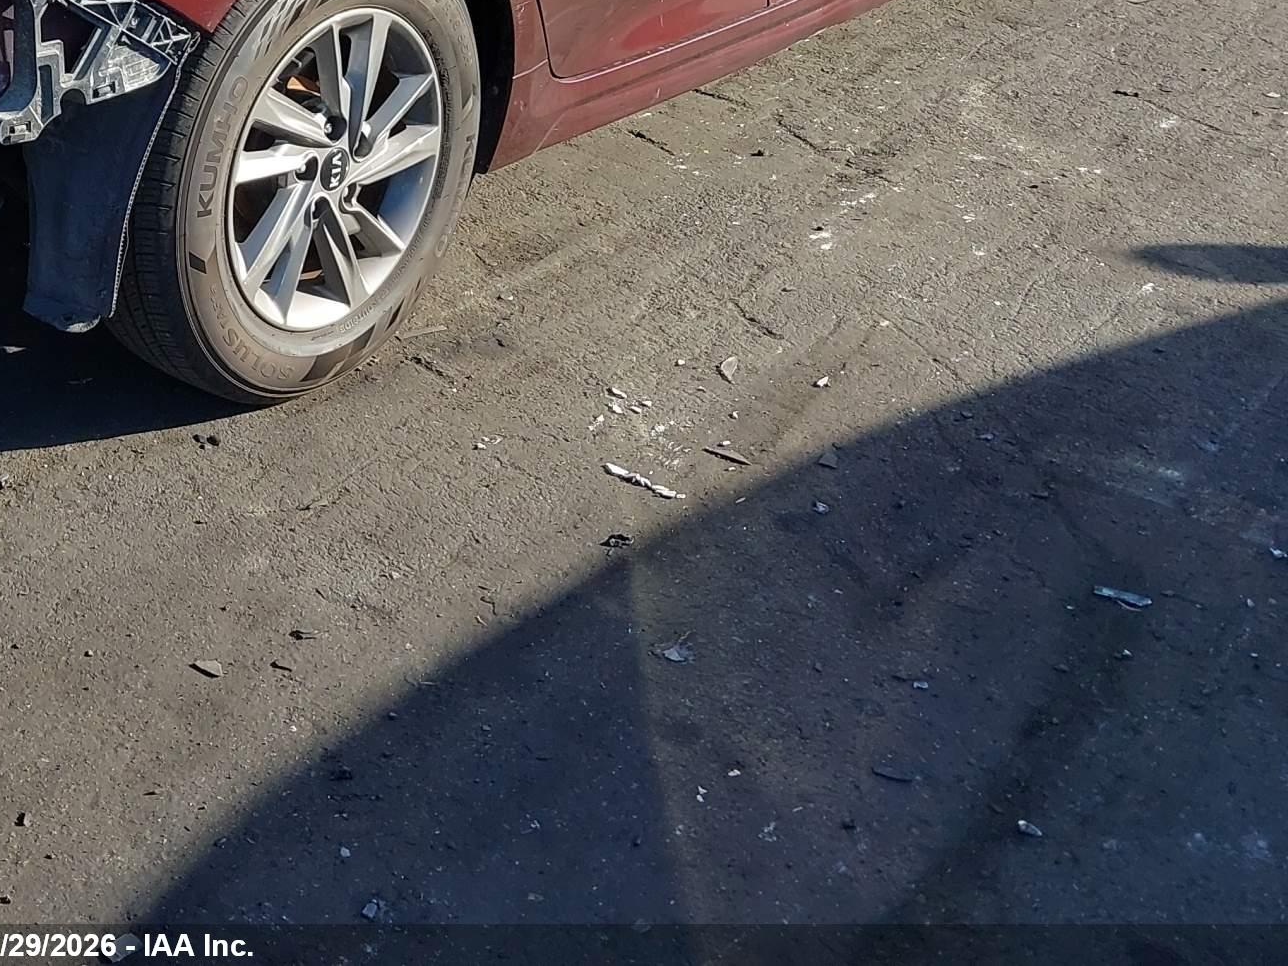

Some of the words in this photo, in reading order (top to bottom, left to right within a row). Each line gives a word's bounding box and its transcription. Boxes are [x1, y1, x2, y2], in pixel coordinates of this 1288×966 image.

[196, 75, 249, 218] KUMHO
[329, 152, 343, 189] KIA
[222, 329, 295, 380] SOLUS
